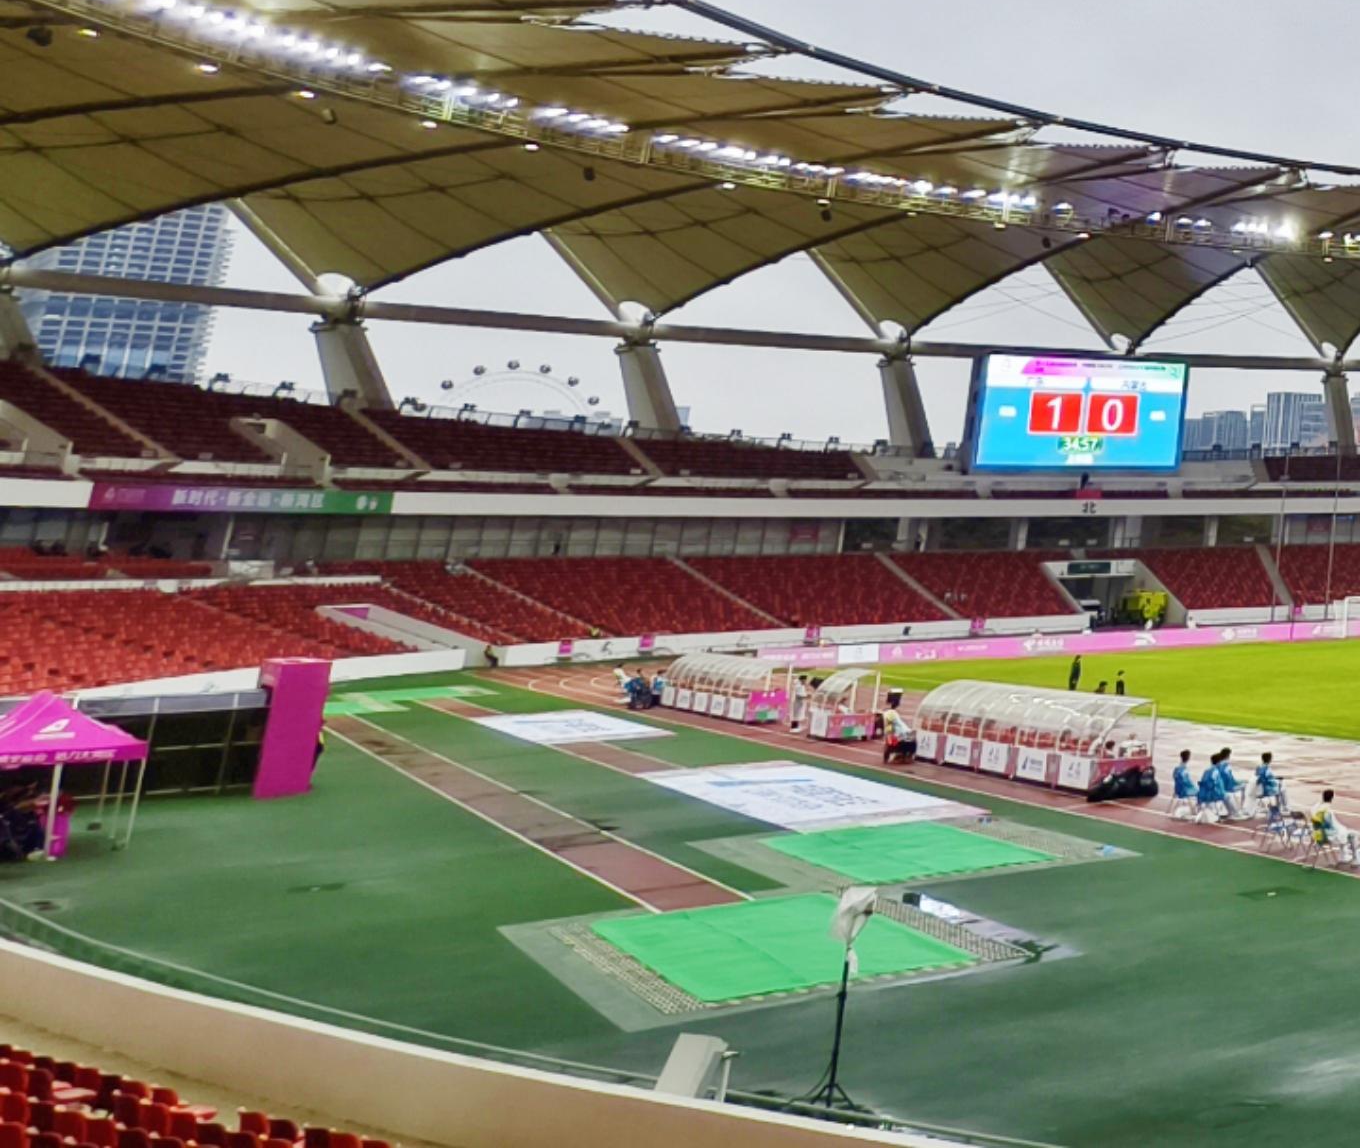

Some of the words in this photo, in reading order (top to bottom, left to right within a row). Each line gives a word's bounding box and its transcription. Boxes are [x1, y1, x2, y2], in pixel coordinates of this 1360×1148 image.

[1047, 396, 1063, 431] 1
[1102, 398, 1124, 431] 0
[1082, 500, 1097, 514] 北
